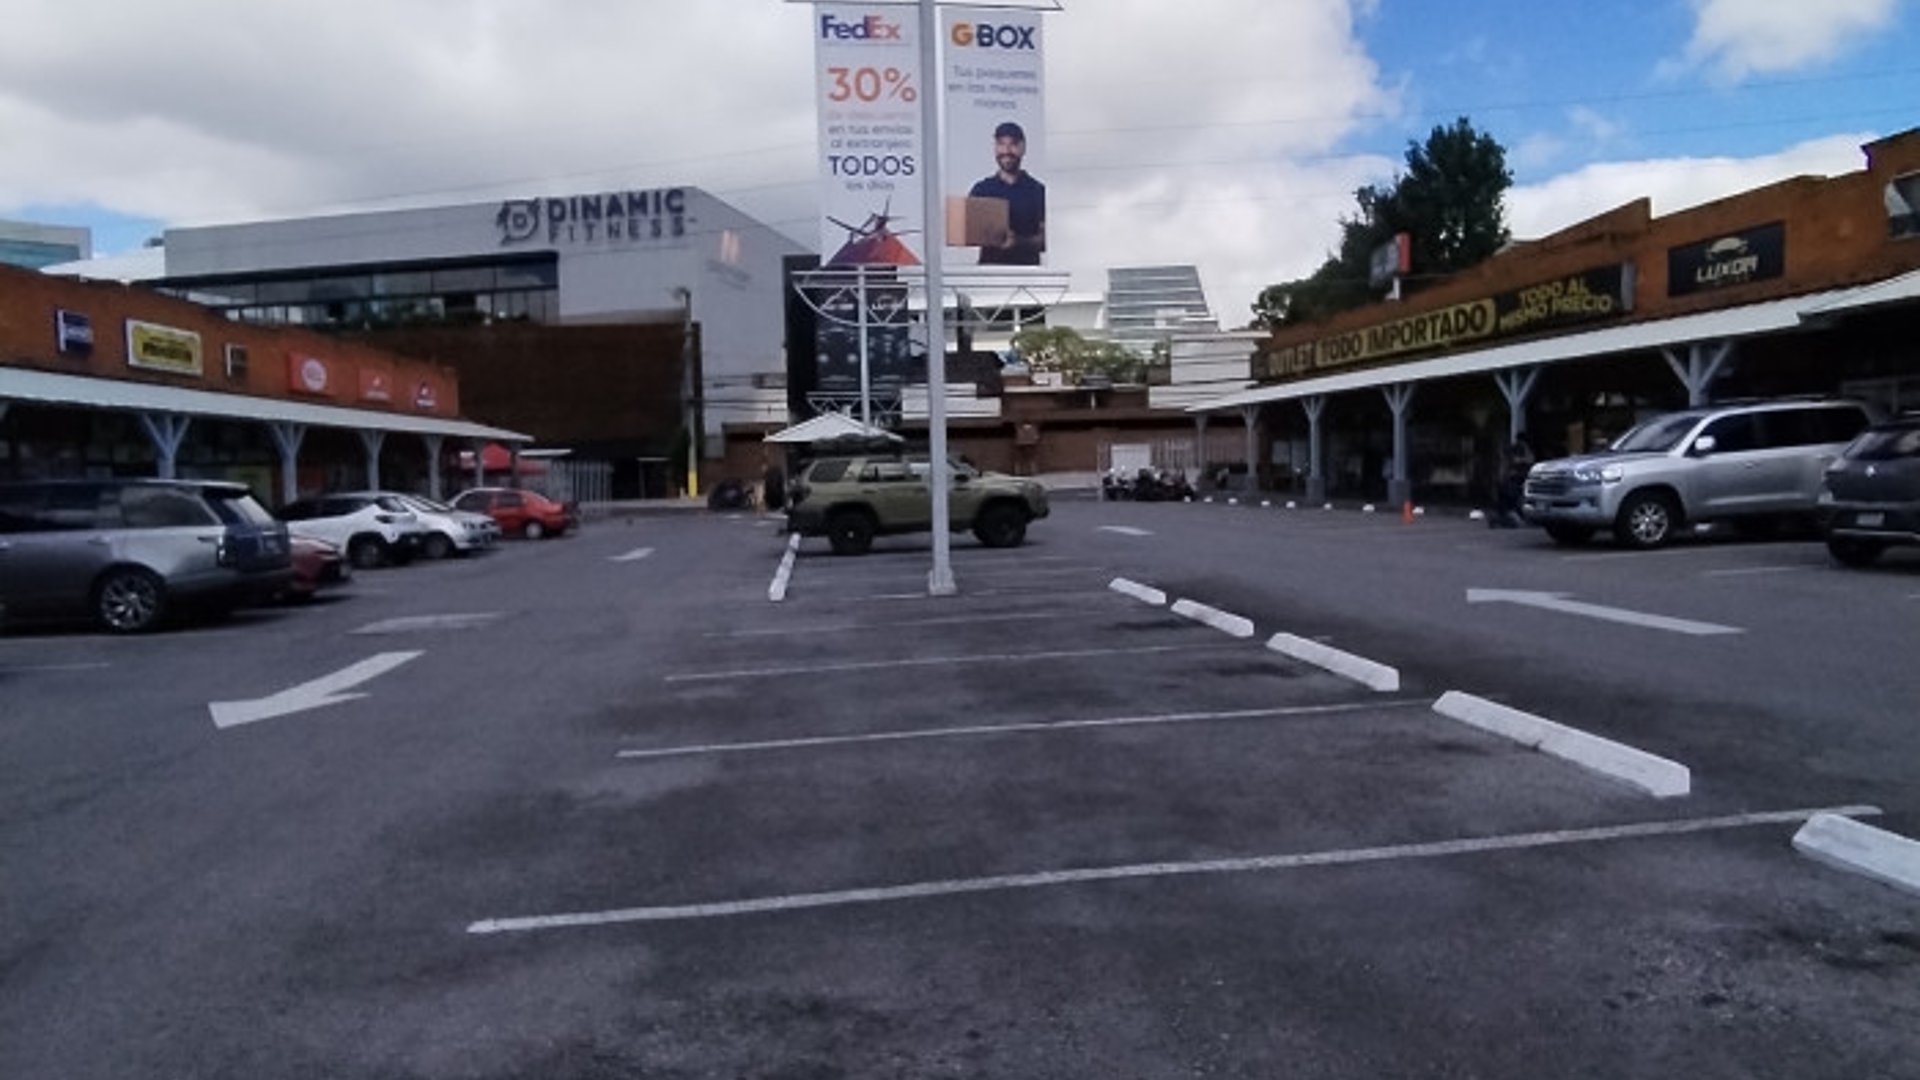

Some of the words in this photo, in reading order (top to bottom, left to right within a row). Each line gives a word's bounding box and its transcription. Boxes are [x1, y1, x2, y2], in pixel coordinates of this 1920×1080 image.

[821, 14, 901, 40] FedEx
[828, 66, 917, 102] 30%
[828, 155, 915, 176] TODOS
[548, 188, 685, 223] DINAMIC
[550, 215, 684, 244] FITNESS
[1319, 332, 1361, 362] TODO
[1366, 304, 1488, 352] IMPORTADO
